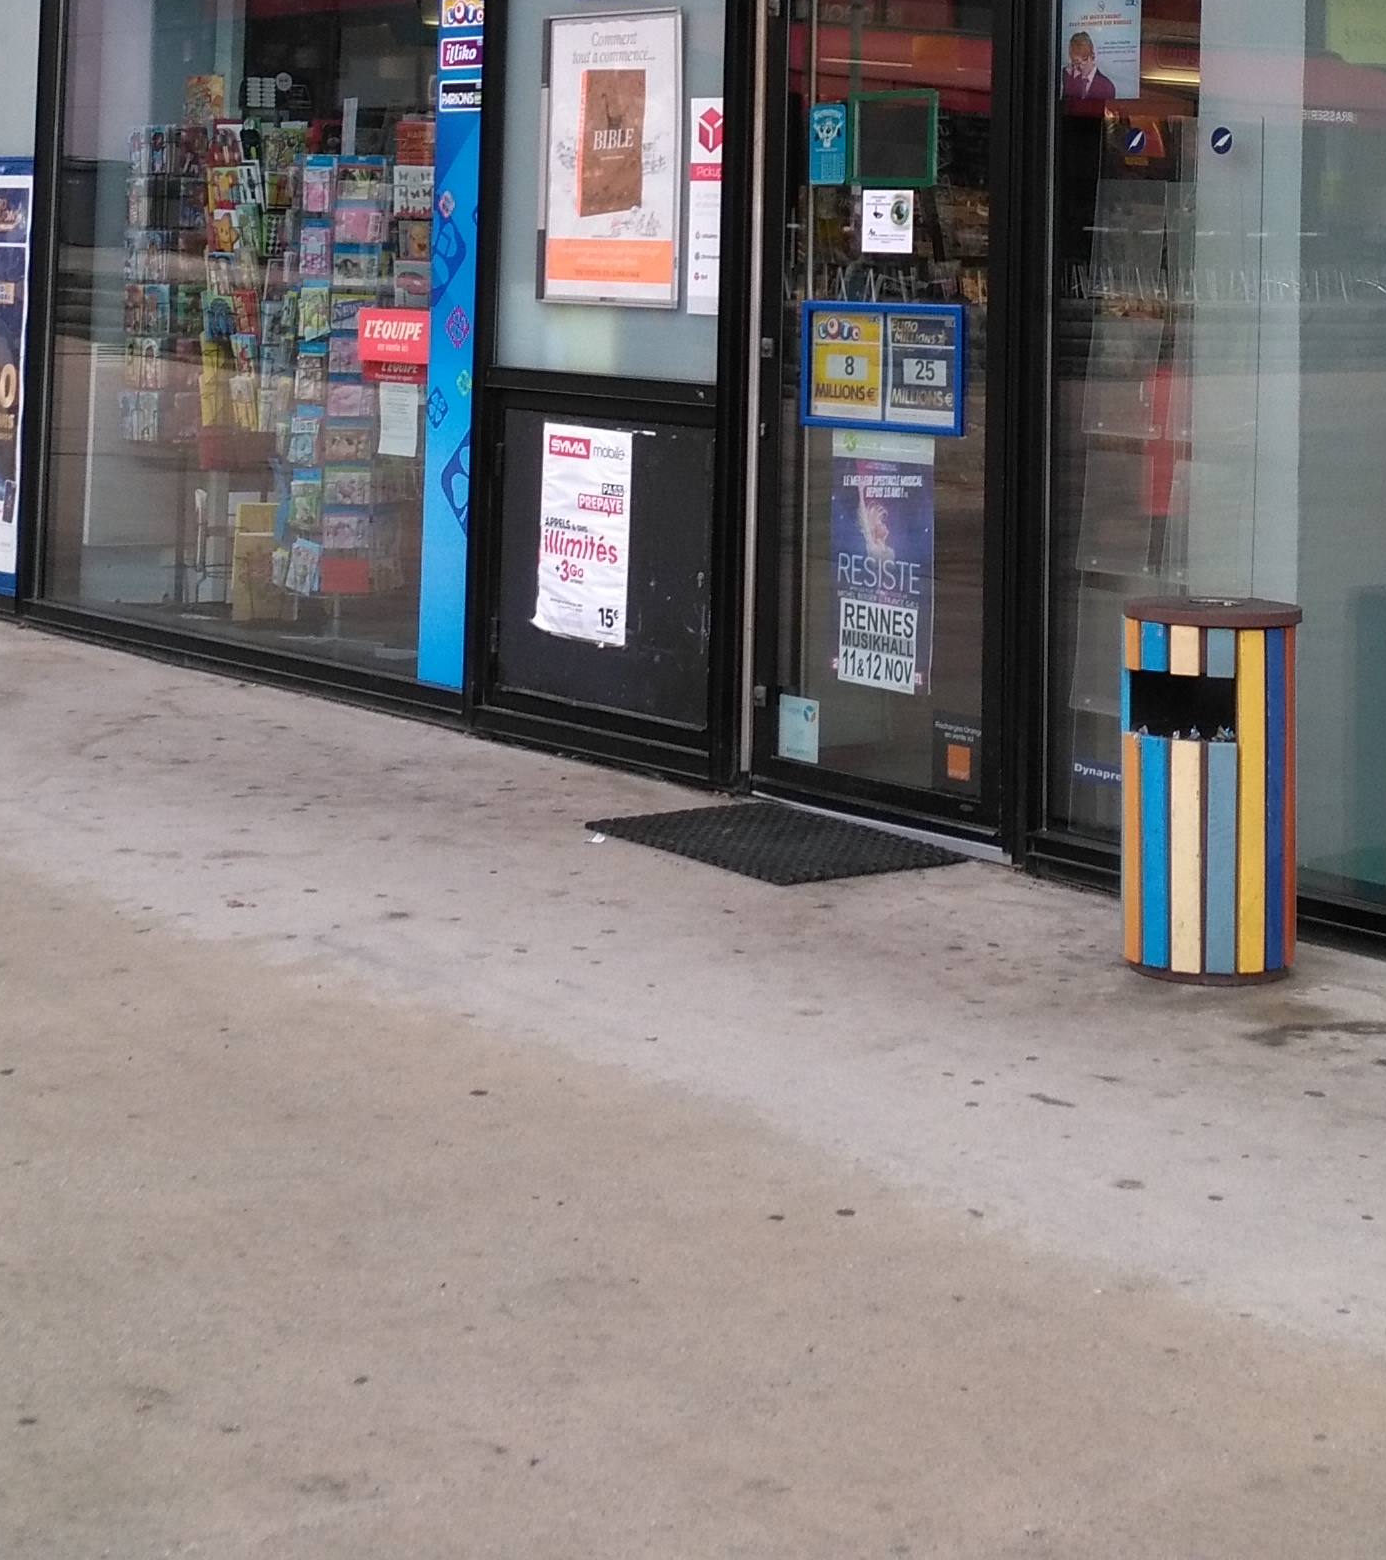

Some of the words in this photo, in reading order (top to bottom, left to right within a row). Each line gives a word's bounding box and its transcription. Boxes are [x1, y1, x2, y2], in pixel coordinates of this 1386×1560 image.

[592, 32, 637, 47] Comment
[445, 44, 477, 65] illiko
[572, 51, 591, 64] tout
[592, 52, 599, 63] a
[441, 92, 474, 105] PARIONS
[593, 128, 635, 151] BIBLE
[363, 319, 424, 341] L'ÉQUIPE
[818, 315, 861, 341] LOTO
[891, 320, 919, 333] EURO
[377, 343, 385, 351] en
[385, 343, 401, 351] vente
[844, 355, 855, 376] 8
[915, 360, 936, 381] 25
[551, 438, 588, 455] SYMA
[593, 446, 625, 460] mobile
[602, 484, 624, 496] PASS
[579, 495, 623, 513] PREPAYE
[545, 517, 570, 530] APPELS
[544, 529, 618, 564] illimités
[837, 552, 921, 595] RESISTE
[844, 602, 914, 639] RENNES
[841, 629, 914, 659] MUSIKHALL
[884, 657, 913, 684] NOV
